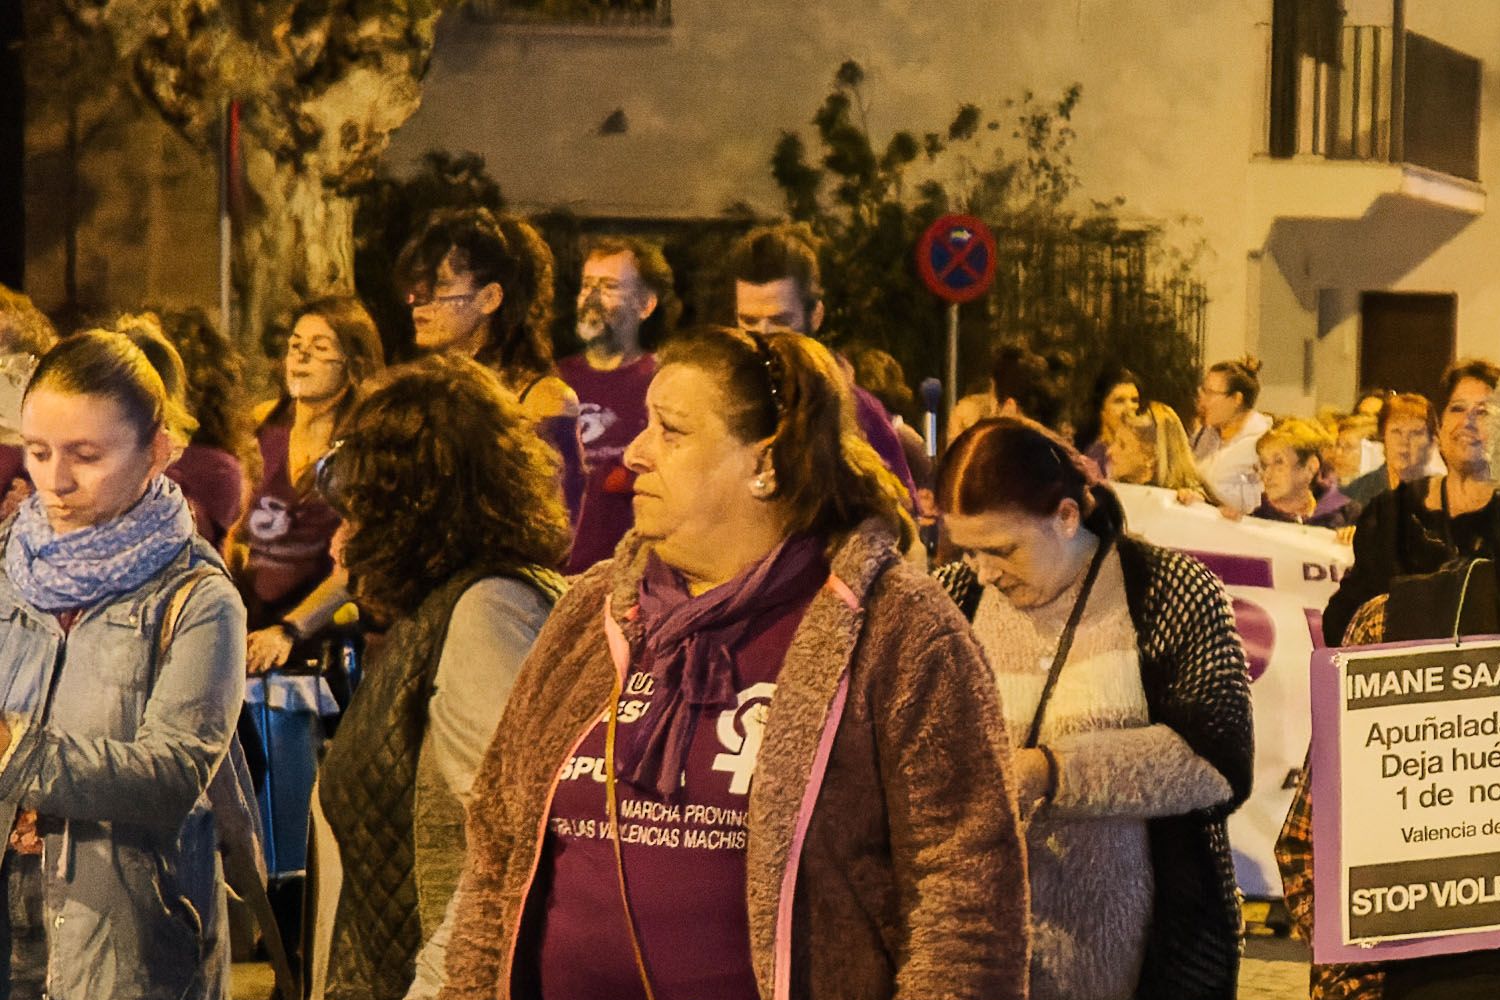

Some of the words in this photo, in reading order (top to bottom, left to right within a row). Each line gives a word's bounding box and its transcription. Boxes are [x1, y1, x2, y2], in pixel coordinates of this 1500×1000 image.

[1347, 667, 1444, 699] IMANE
[1381, 751, 1443, 780] Deja
[1396, 786, 1409, 810] 1
[1419, 782, 1454, 808] de
[621, 799, 681, 823] MARCHA
[599, 821, 680, 848] VILENCIAS
[1401, 822, 1477, 844] Valencia
[1351, 883, 1429, 917] STOP
